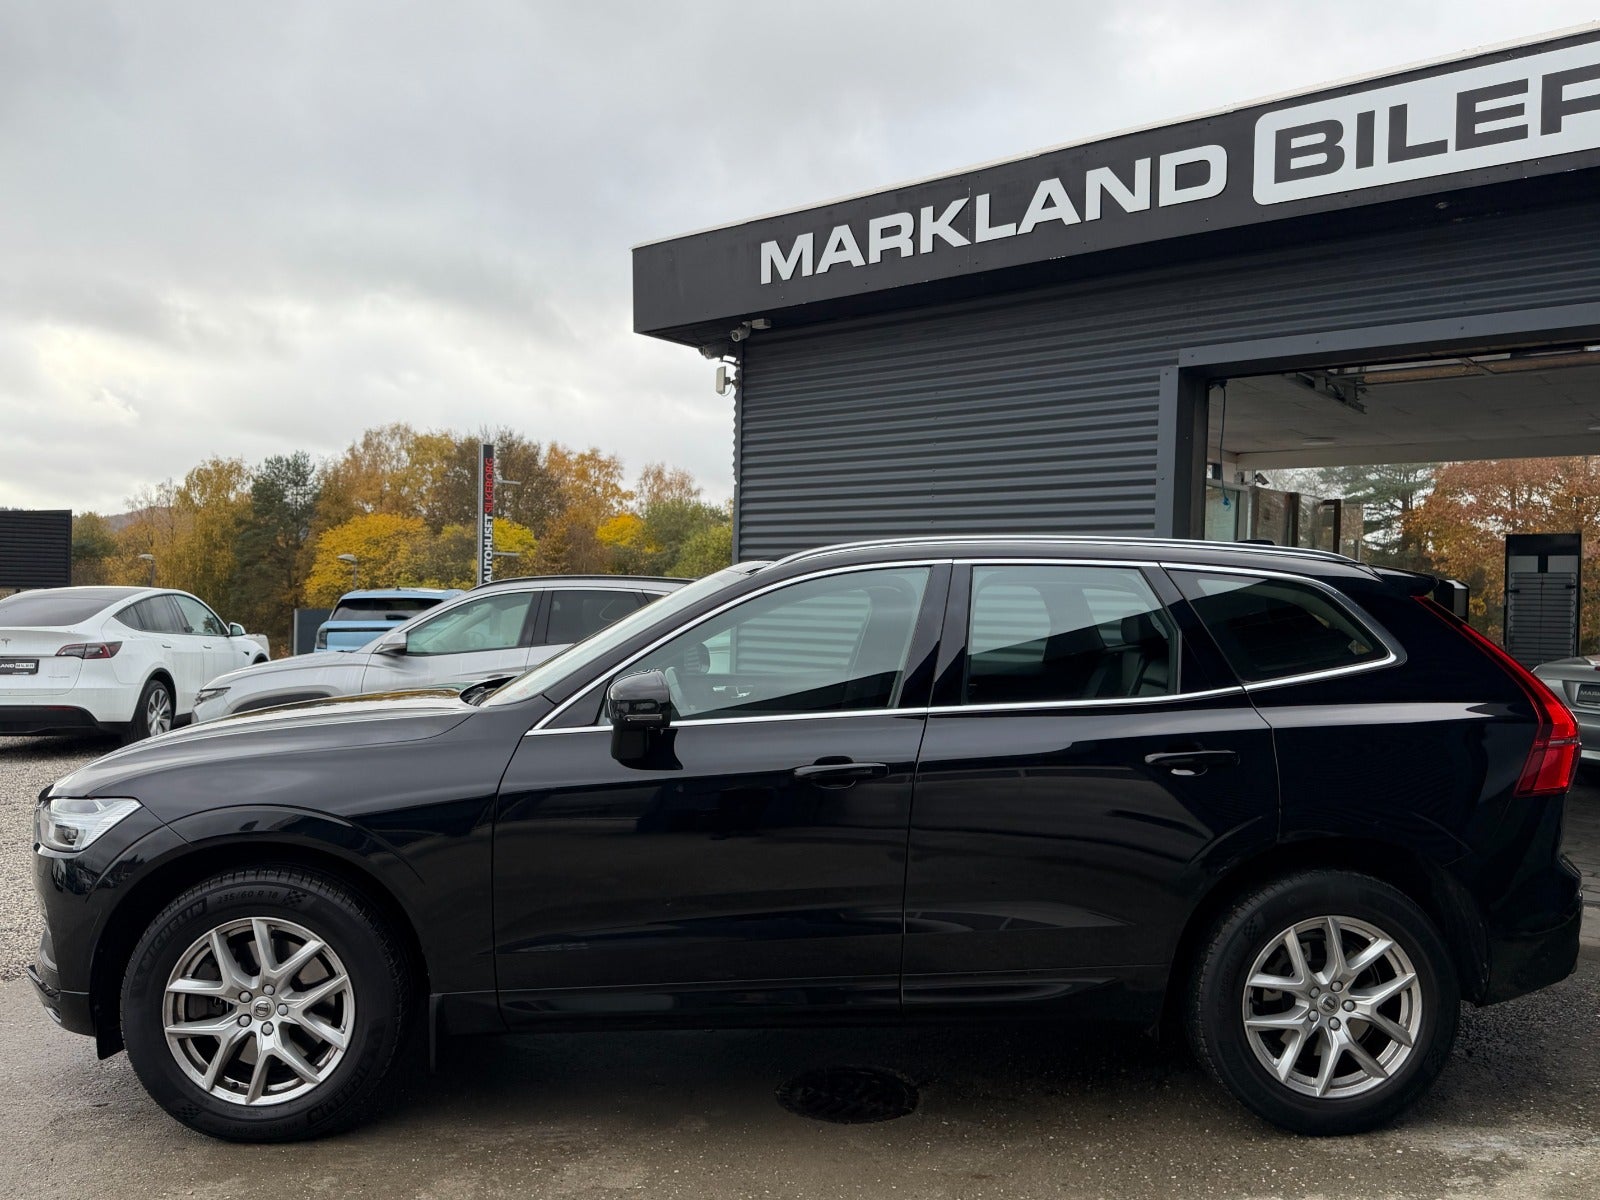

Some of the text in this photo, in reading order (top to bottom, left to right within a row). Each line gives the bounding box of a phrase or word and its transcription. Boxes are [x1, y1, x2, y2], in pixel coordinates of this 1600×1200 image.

[760, 144, 1228, 285] MARKLAND
[483, 458, 493, 583] AUTOHUSET SILKEBORG
[141, 898, 208, 967] MICHELIN
[217, 890, 253, 904] 235/60
